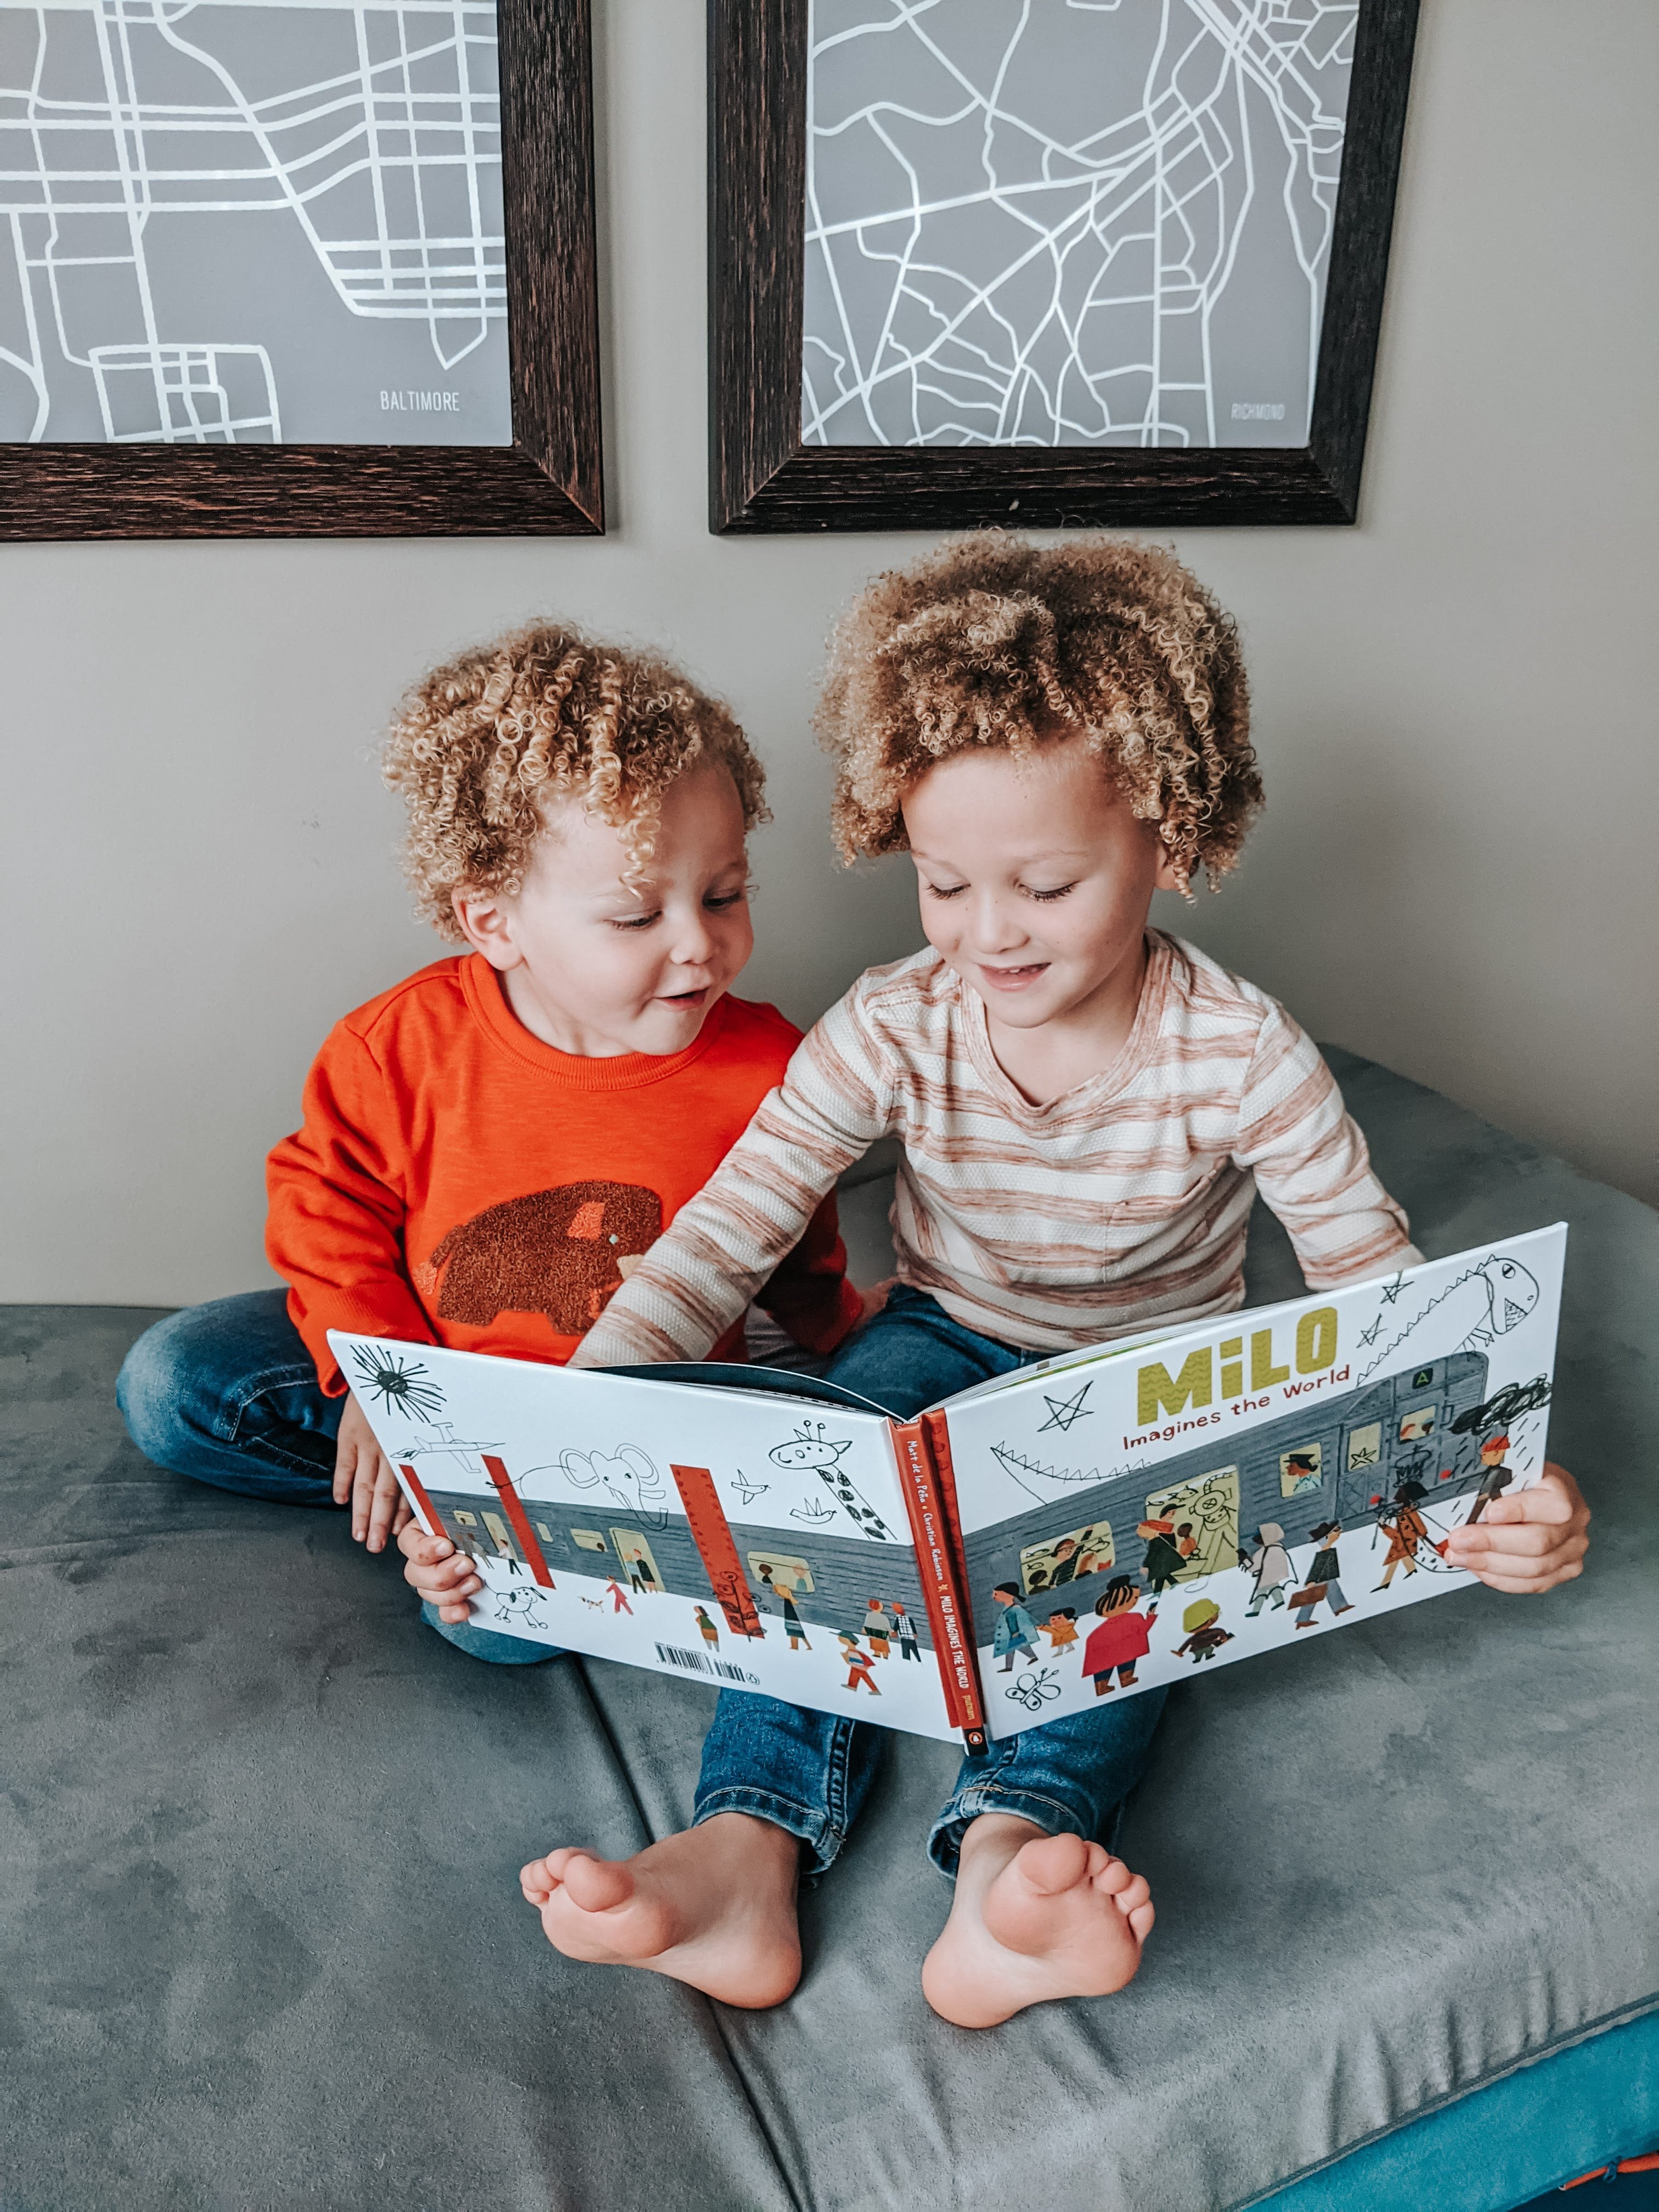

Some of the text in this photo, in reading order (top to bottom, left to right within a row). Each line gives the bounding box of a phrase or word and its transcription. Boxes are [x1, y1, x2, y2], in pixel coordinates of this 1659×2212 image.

[380, 391, 460, 411] BALTIMORE
[1231, 403, 1285, 420] RICHMOND
[1123, 1365, 1350, 1450] Imagines the World
[907, 1441, 918, 1461] Matt
[912, 1464, 923, 1473] de
[917, 1485, 928, 1503] Peña
[923, 1513, 936, 1546] Christian
[932, 1549, 943, 1580] Robinson
[940, 1596, 953, 1613] MILO
[944, 1615, 962, 1649] IMAGINES
[952, 1650, 965, 1665] THE
[955, 1666, 969, 1689] WORLD
[962, 1694, 975, 1720] putnam
